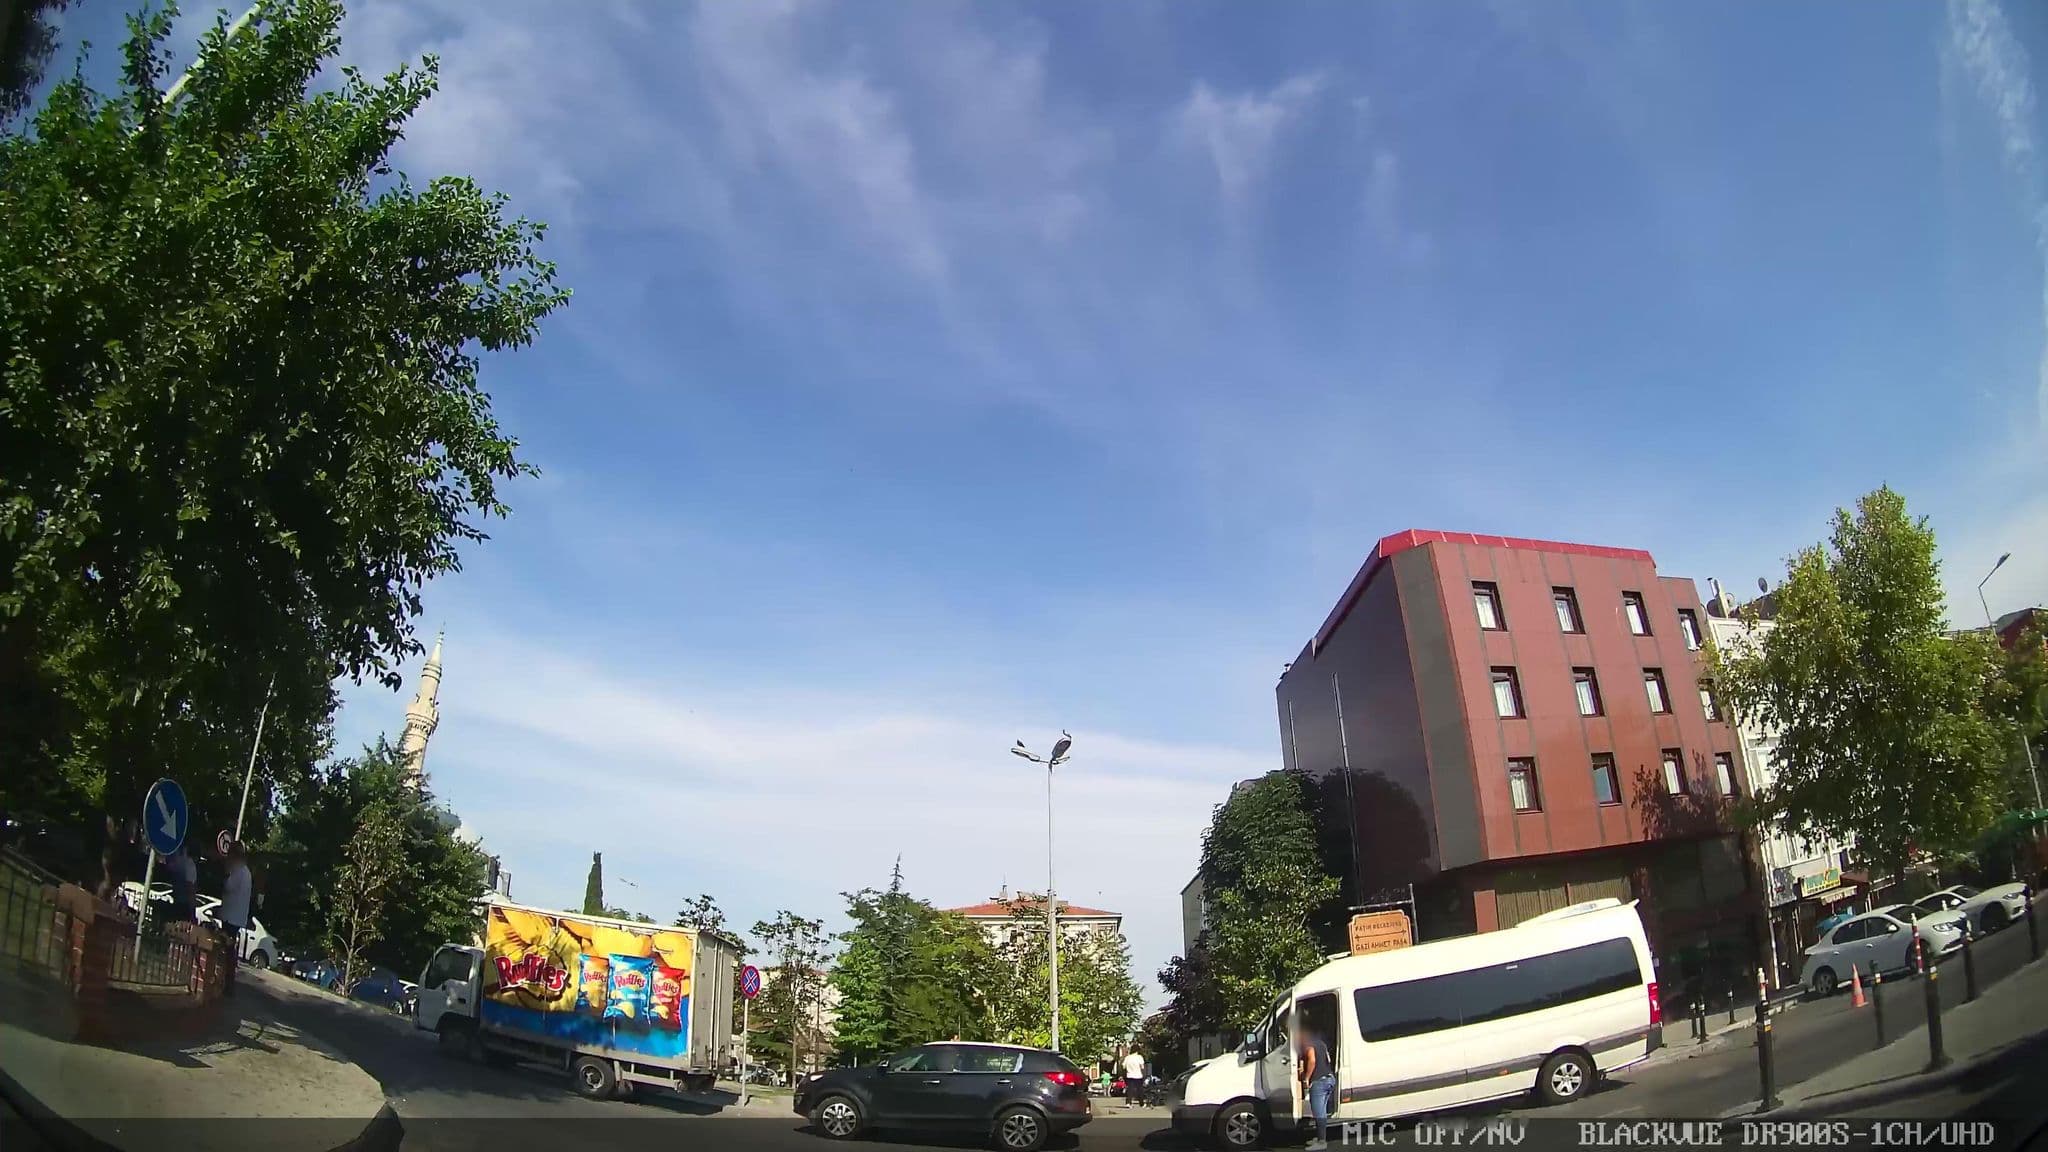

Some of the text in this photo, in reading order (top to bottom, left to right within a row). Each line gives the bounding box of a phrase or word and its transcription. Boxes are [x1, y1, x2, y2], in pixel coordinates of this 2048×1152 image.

[495, 952, 568, 991] Ruffles
[614, 973, 646, 988] Ruffles
[652, 981, 680, 994] Ruffles
